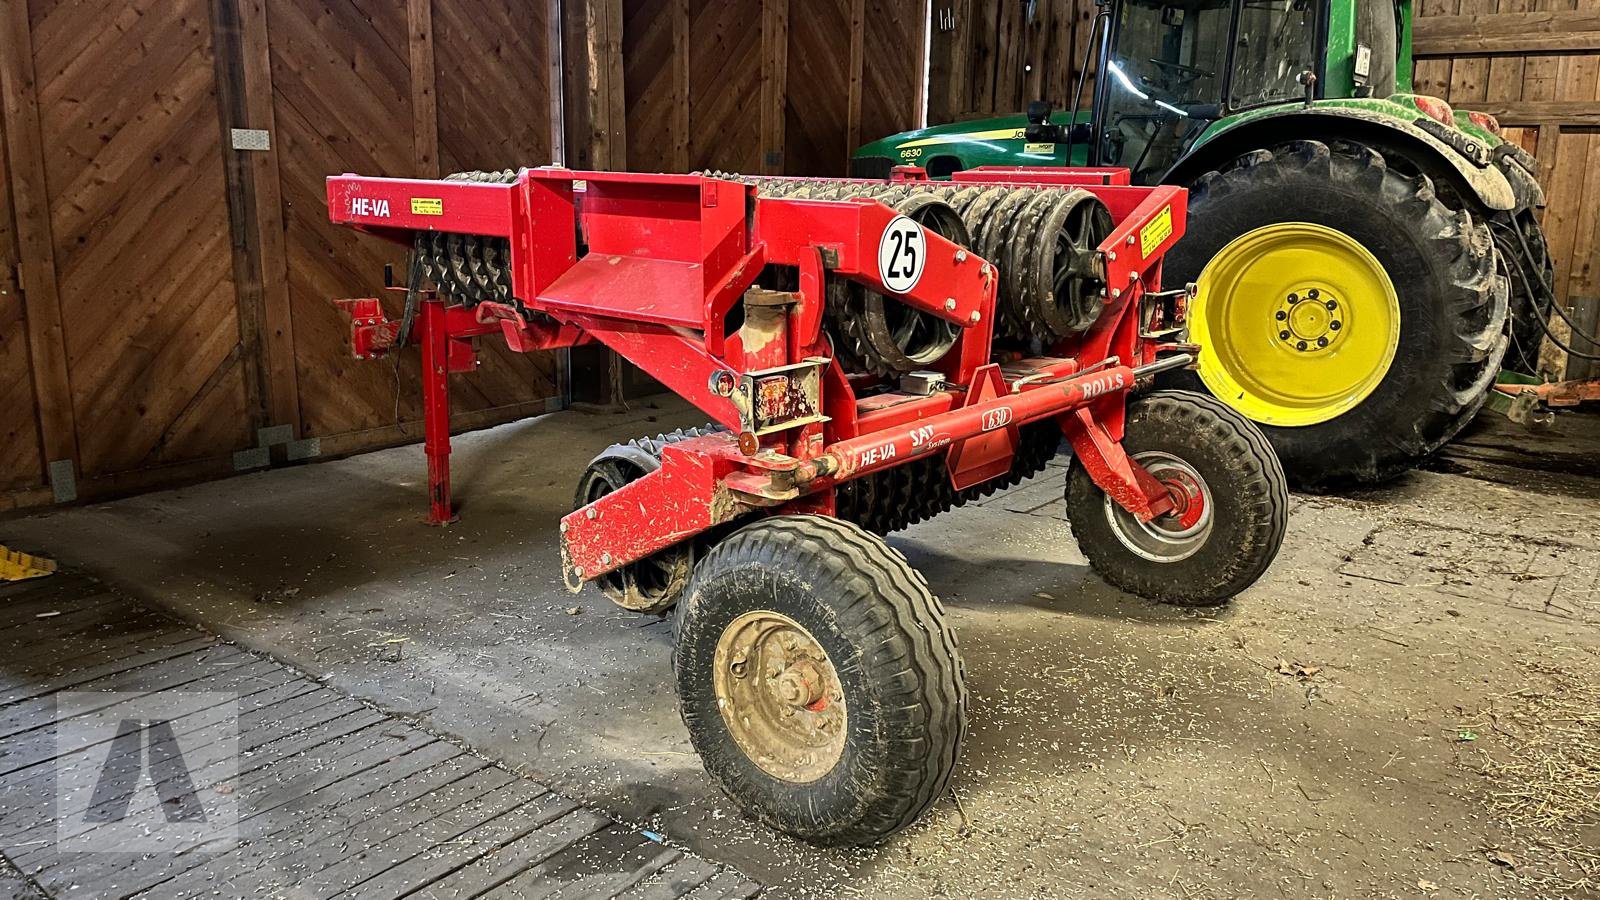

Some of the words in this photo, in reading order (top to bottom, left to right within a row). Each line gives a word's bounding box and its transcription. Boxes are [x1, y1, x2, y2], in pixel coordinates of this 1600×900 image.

[900, 148, 922, 158] 6630
[352, 197, 390, 217] HE-VA
[888, 230, 917, 278] 25
[1082, 373, 1124, 400] ROLLS
[989, 409, 1006, 429] 630
[860, 443, 896, 467] HE-VA
[909, 425, 934, 446] SAT
